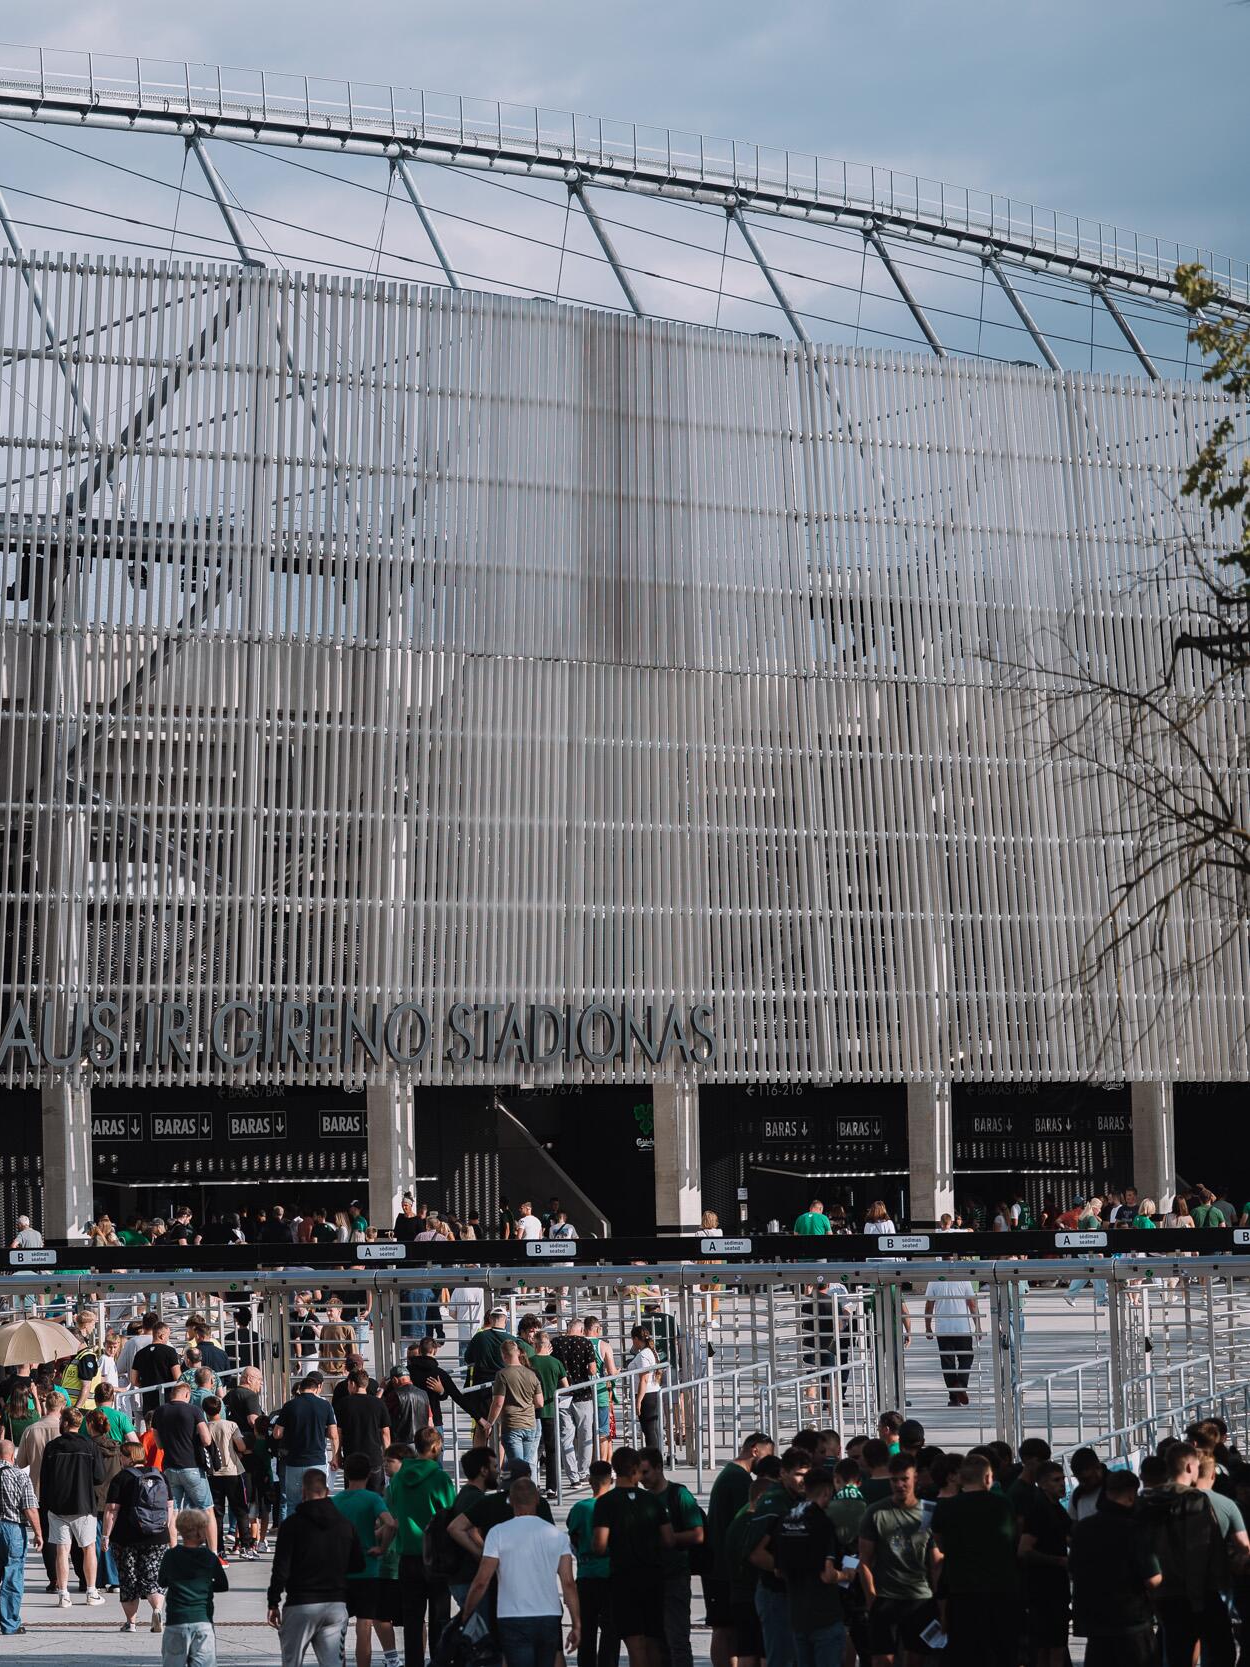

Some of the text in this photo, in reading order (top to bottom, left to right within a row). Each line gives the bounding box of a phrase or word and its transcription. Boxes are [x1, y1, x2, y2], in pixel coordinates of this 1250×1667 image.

[143, 1002, 191, 1065] IR
[213, 1001, 431, 1065] GIRENO
[447, 1002, 717, 1065] STADIONAS
[758, 1084, 803, 1097] 116-216
[91, 1119, 126, 1136] ARAS
[154, 1118, 197, 1135] BARAS
[231, 1117, 271, 1135] BARAS
[322, 1116, 361, 1132] BARAS
[765, 1121, 797, 1137] BARAS
[839, 1121, 870, 1137] BARAS
[974, 1117, 1003, 1133] BARAS
[1034, 1117, 1063, 1133] BARAS
[1097, 1115, 1126, 1131] BARAS
[709, 1241, 717, 1251] A
[887, 1238, 894, 1248] B
[1063, 1235, 1071, 1245] A
[364, 1248, 372, 1257] A
[535, 1244, 542, 1254] B
[17, 1253, 25, 1262] B
